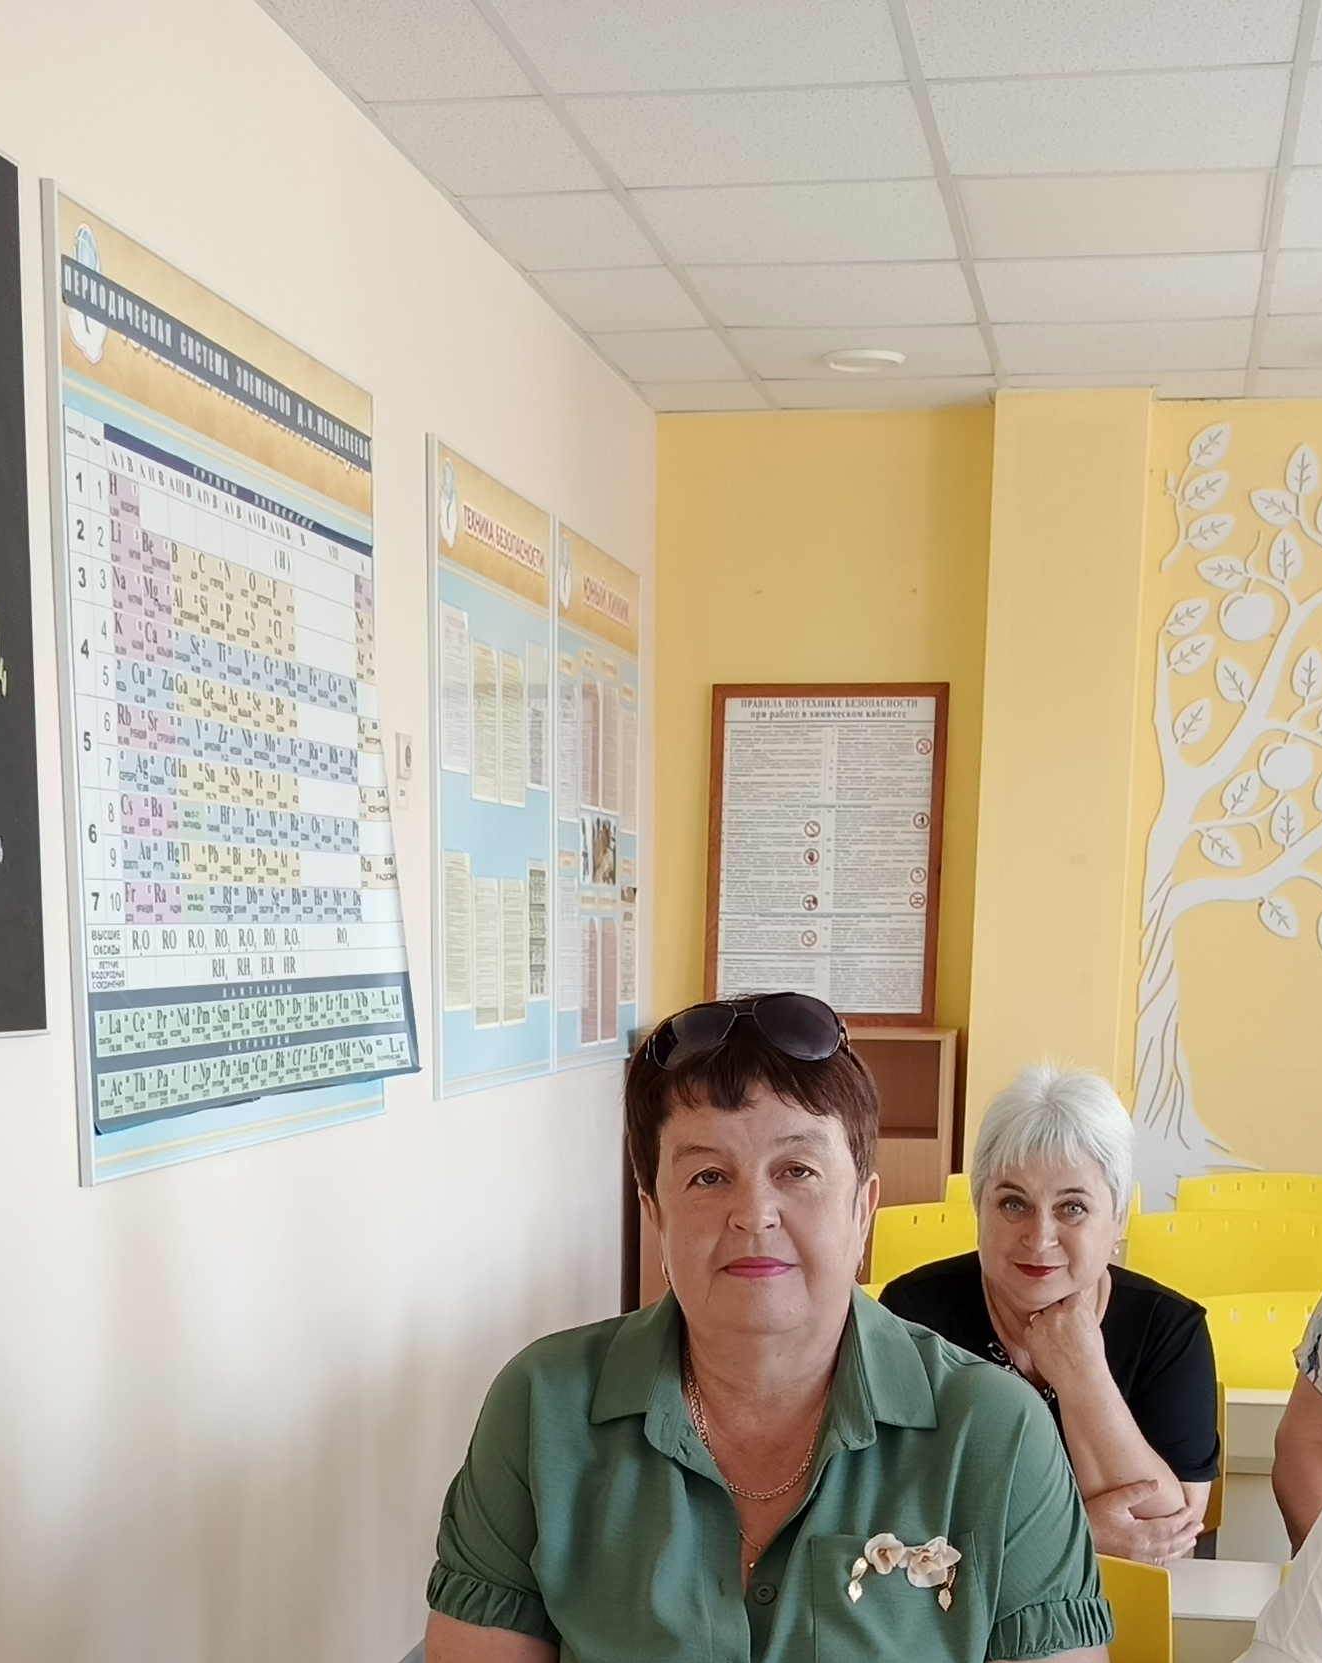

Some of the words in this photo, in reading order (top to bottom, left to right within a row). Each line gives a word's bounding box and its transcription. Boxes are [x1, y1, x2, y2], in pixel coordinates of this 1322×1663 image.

[64, 264, 172, 348] ПЕРИОДИЧЕСКАЯ
[180, 332, 229, 381] СИСТЕМА
[236, 365, 291, 416] ЭЛЕМЕНТОВ
[76, 471, 83, 493] 1
[109, 473, 118, 496] H
[77, 518, 85, 541] 2
[97, 526, 104, 548] 2
[110, 519, 121, 544] Li
[142, 530, 154, 555] Be
[78, 566, 86, 588] 3
[99, 568, 107, 590] 3
[113, 566, 126, 591] Na
[114, 611, 123, 635] K
[144, 621, 157, 644] Ca
[80, 638, 89, 659] 4
[102, 665, 109, 686] 5
[131, 662, 145, 685] Cu
[741, 699, 782, 708] ПРАВИЛА
[785, 699, 798, 708] ПО
[802, 699, 843, 708] ТЕХНИКЕ
[845, 699, 917, 708] БЕЗОПАСНОСТИ
[104, 712, 111, 732] 6
[117, 702, 131, 726] Rb
[83, 731, 91, 751] 5
[106, 757, 112, 777] 7
[108, 803, 114, 822] 8
[88, 823, 98, 844] 6
[110, 848, 117, 867] 9
[91, 892, 99, 911] 7
[110, 893, 121, 911] 10
